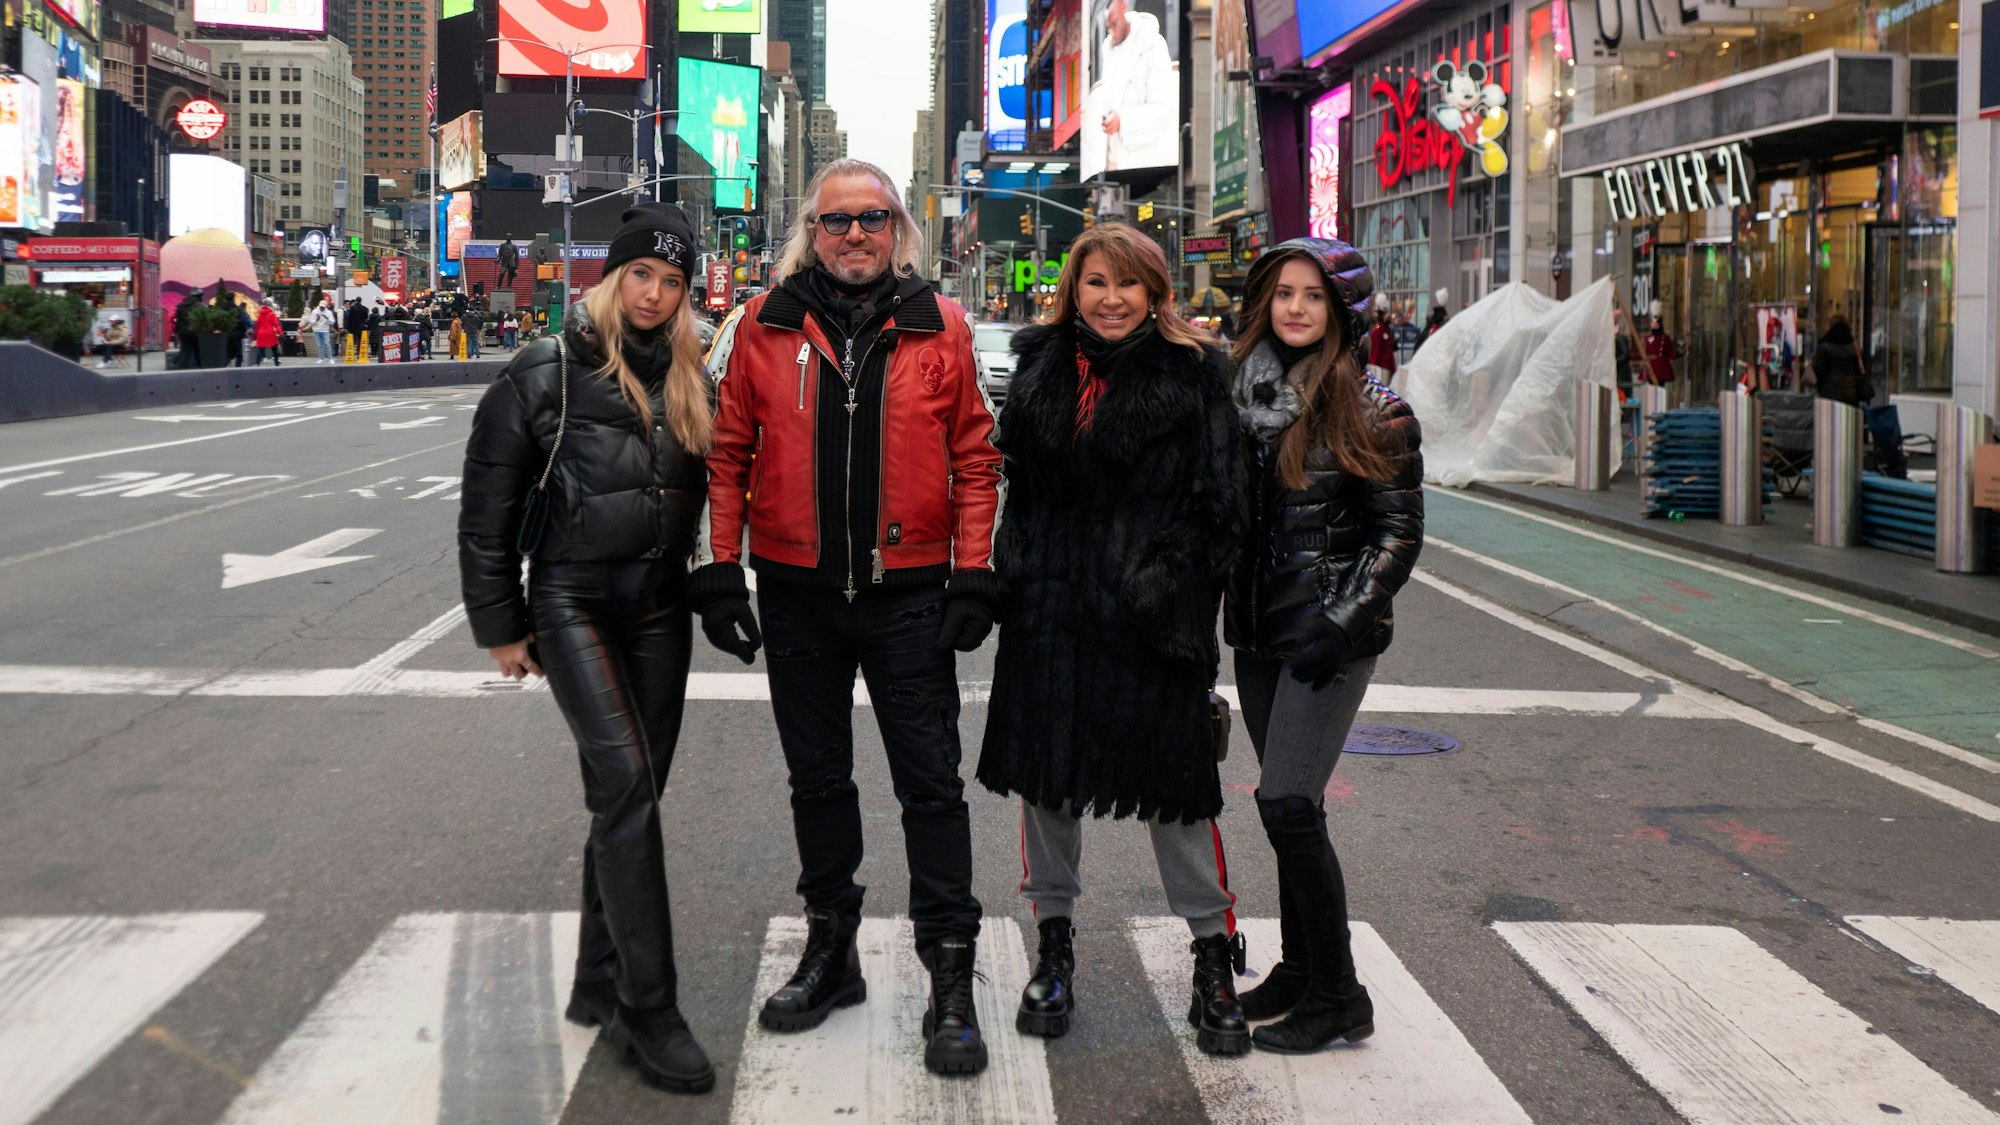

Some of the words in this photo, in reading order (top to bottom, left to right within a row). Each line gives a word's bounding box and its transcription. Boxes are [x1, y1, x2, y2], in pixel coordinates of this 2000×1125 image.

[1603, 151, 1716, 222] FOREVER
[1718, 143, 1752, 206] 21
[32, 245, 81, 254] COFFEED
[654, 231, 687, 266] NY
[388, 260, 401, 289] tkts
[714, 265, 728, 293] tkts
